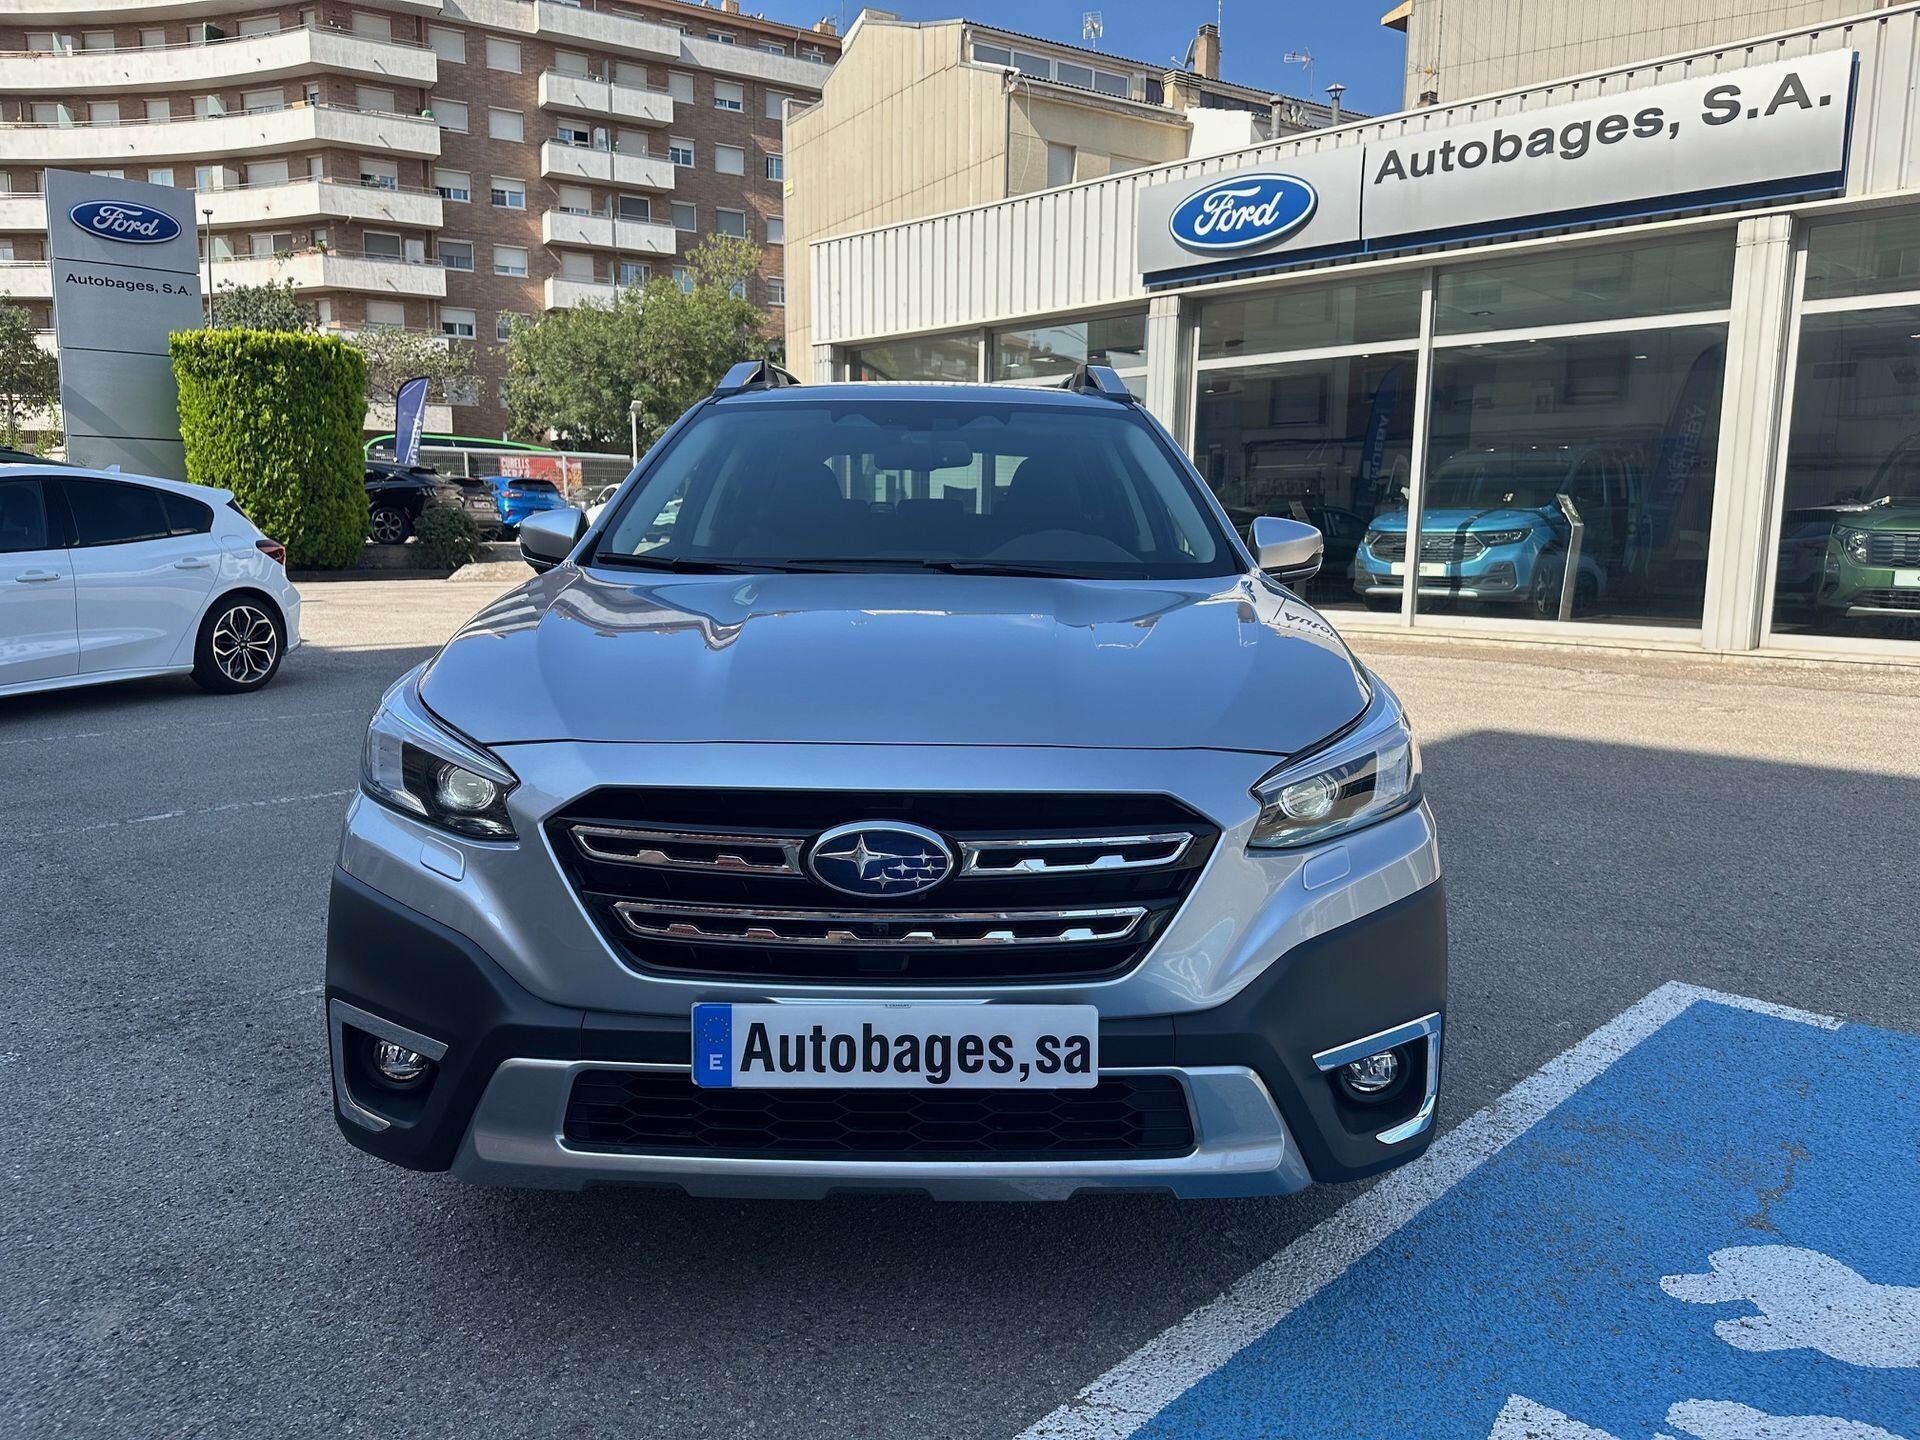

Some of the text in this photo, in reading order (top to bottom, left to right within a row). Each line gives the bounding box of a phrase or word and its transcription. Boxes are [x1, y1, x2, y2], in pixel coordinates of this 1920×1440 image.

[1373, 72, 1832, 184] Autobages, S.A.
[93, 206, 159, 236] Ford
[1193, 185, 1284, 236] Ford
[65, 273, 193, 297] Autobages, S.A.
[709, 1053, 724, 1070] E
[739, 1022, 1091, 1084] Autobages,sa
